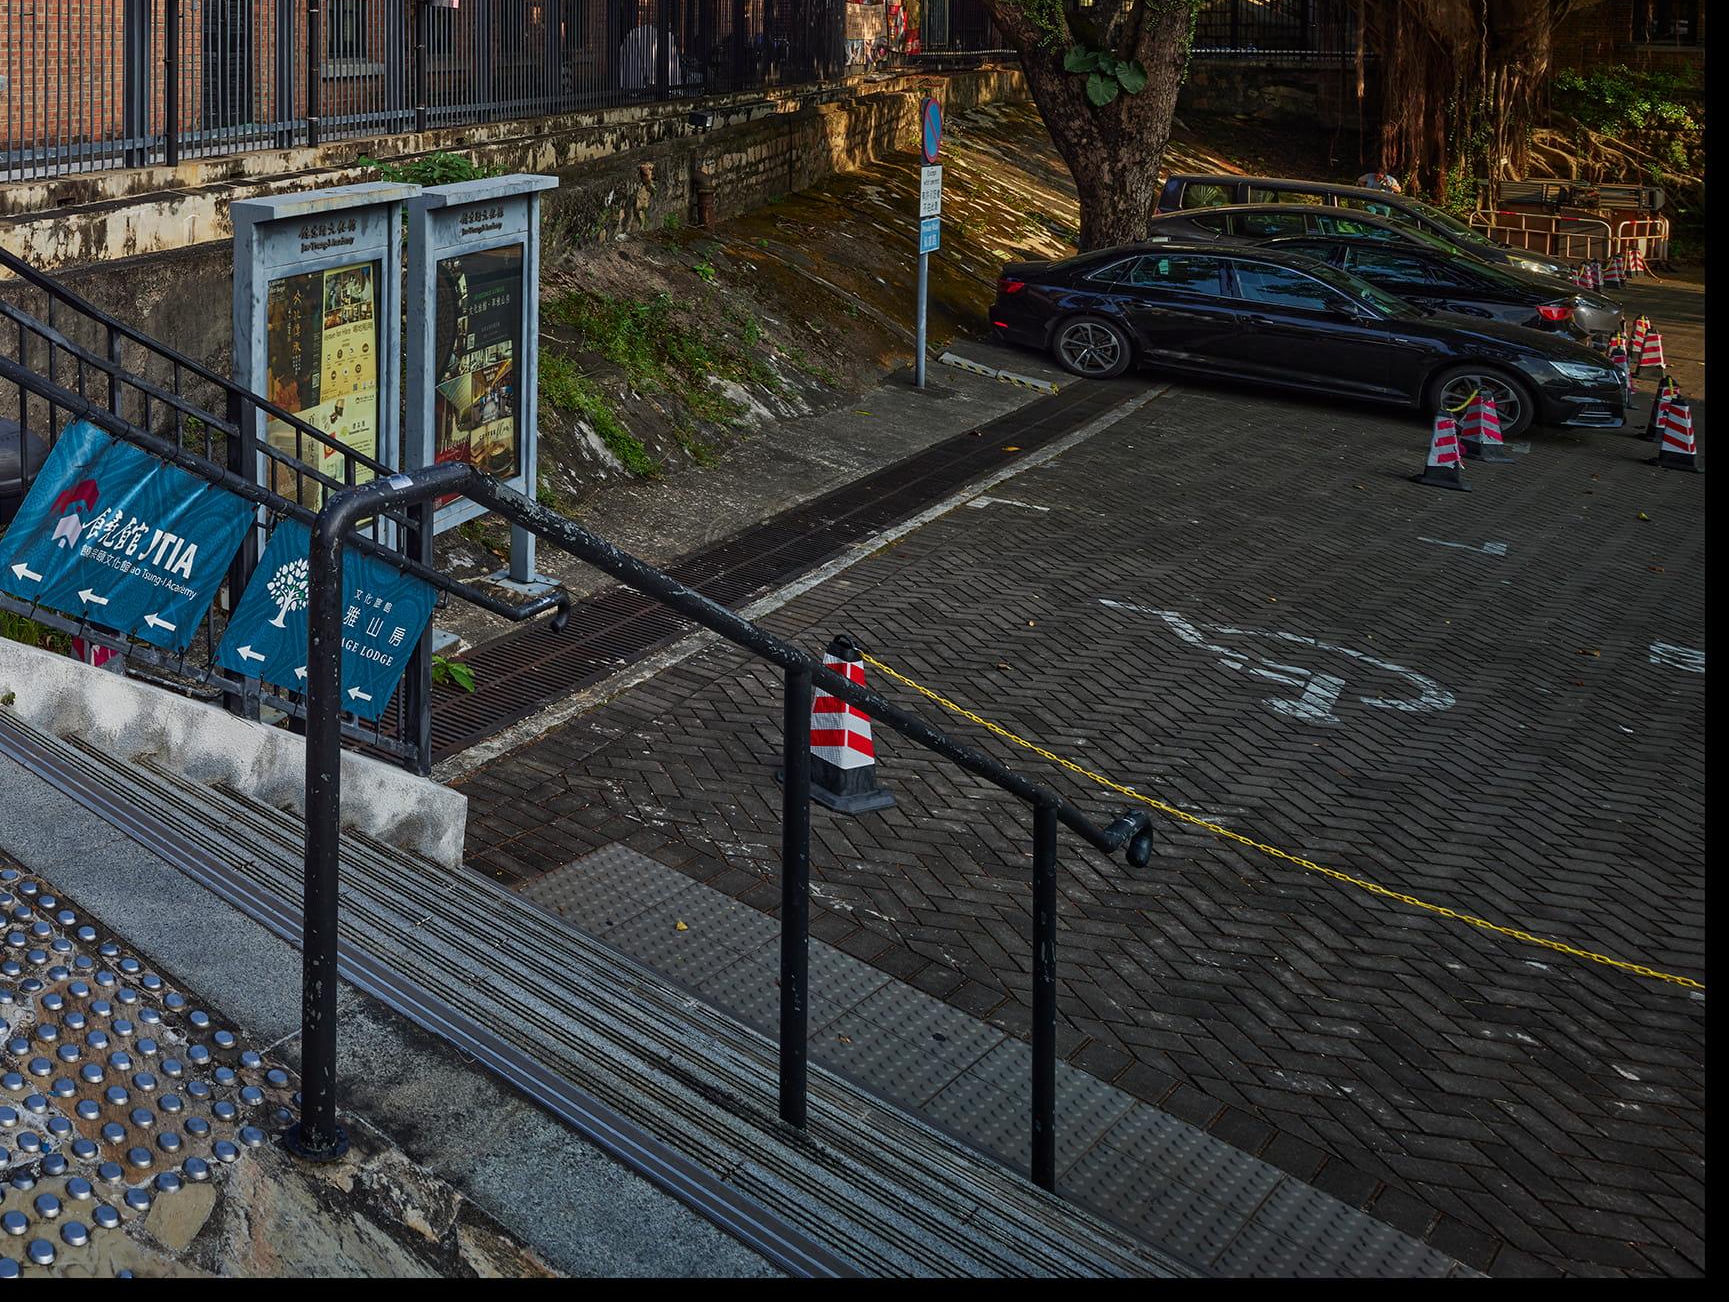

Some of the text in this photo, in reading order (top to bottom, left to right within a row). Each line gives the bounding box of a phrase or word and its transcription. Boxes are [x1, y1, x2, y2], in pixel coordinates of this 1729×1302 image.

[82, 507, 150, 556] 饒館
[138, 529, 198, 580] JTIA
[167, 579, 197, 601] Academy
[360, 645, 394, 667] LODGE
